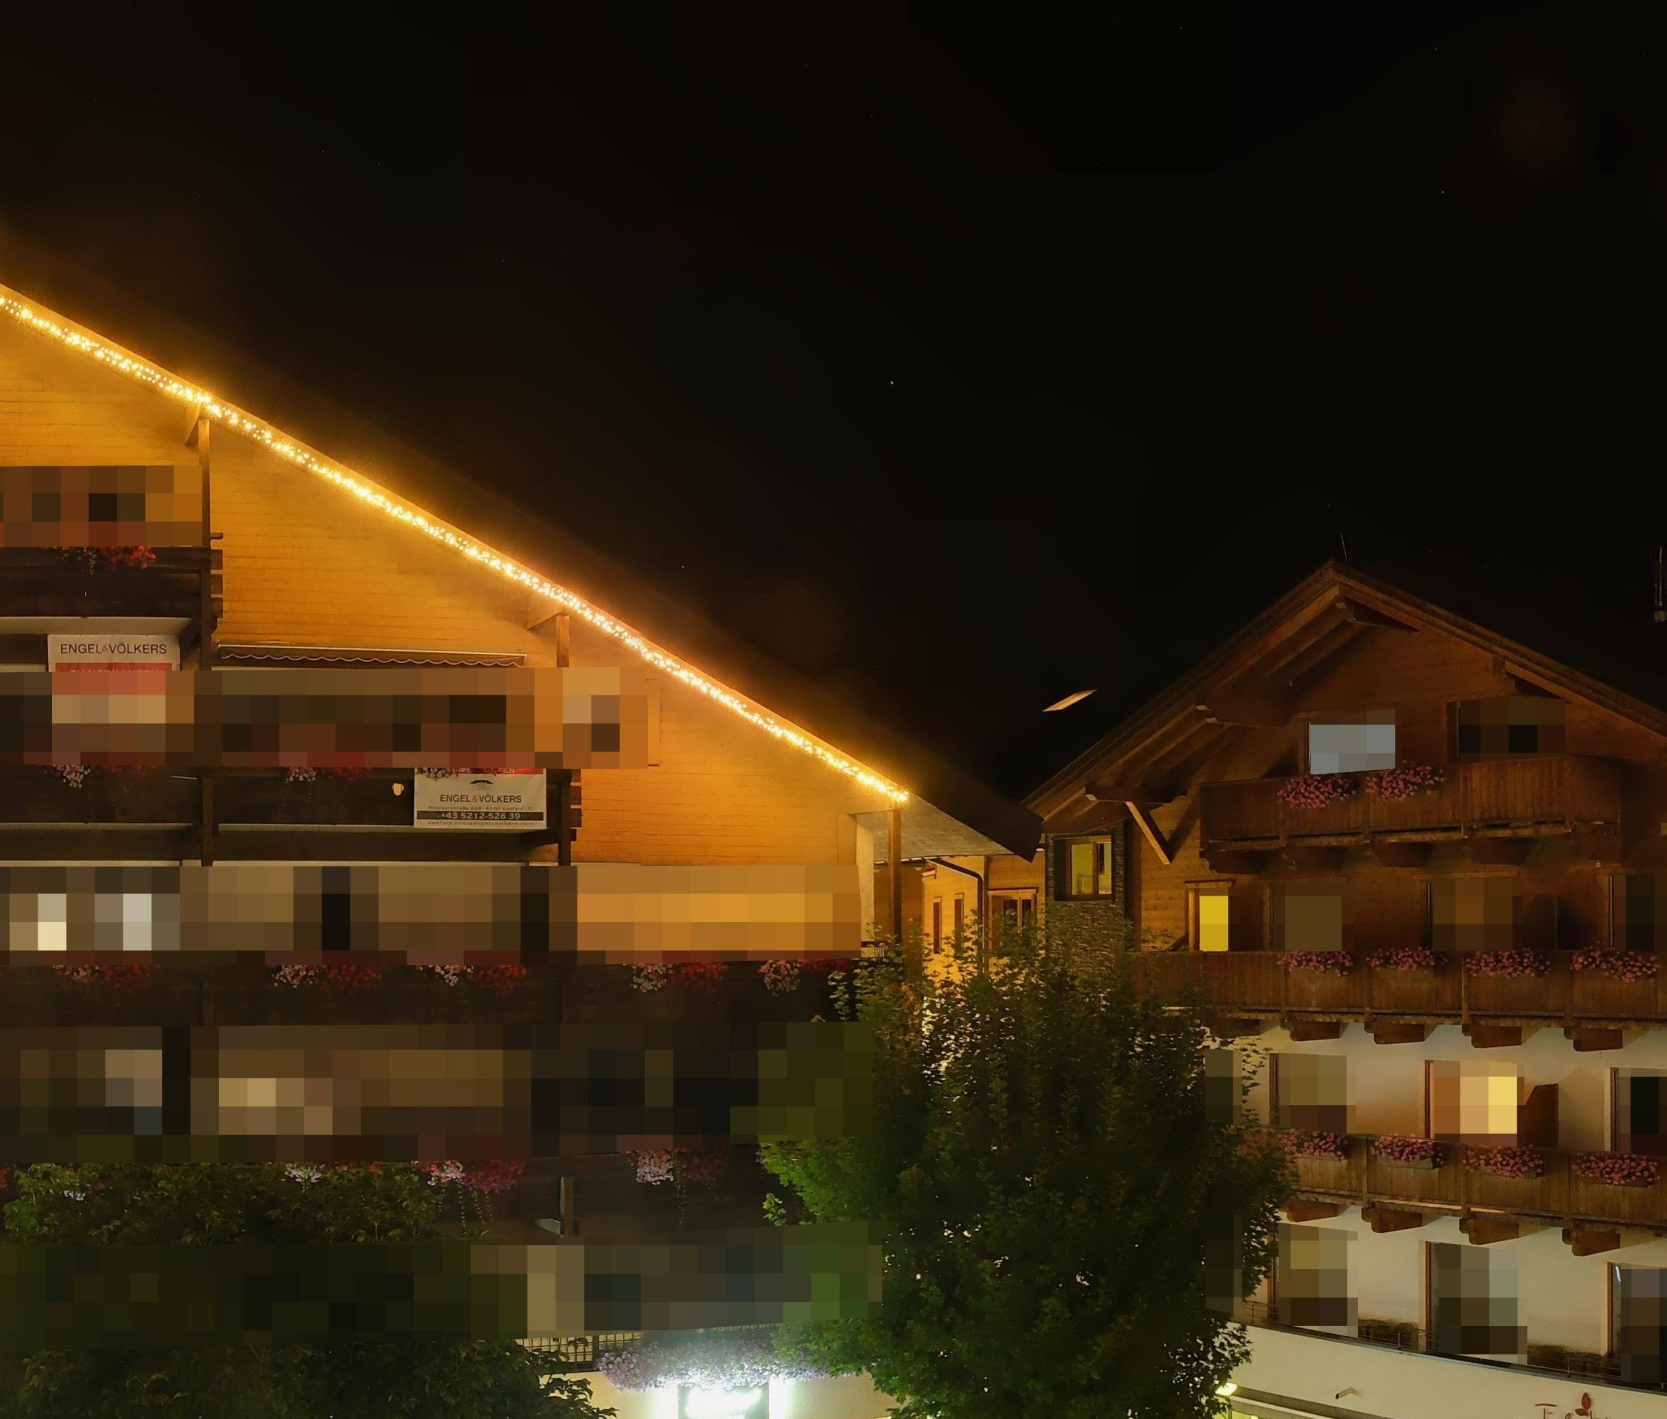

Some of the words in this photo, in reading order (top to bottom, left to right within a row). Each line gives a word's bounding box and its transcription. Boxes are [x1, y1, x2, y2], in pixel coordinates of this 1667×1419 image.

[60, 642, 167, 654] ENGEL&VÖLKERS
[439, 794, 523, 804] ENGEL&VÖLKERS
[461, 812, 506, 820] 5212-526
[509, 812, 521, 820] 39
